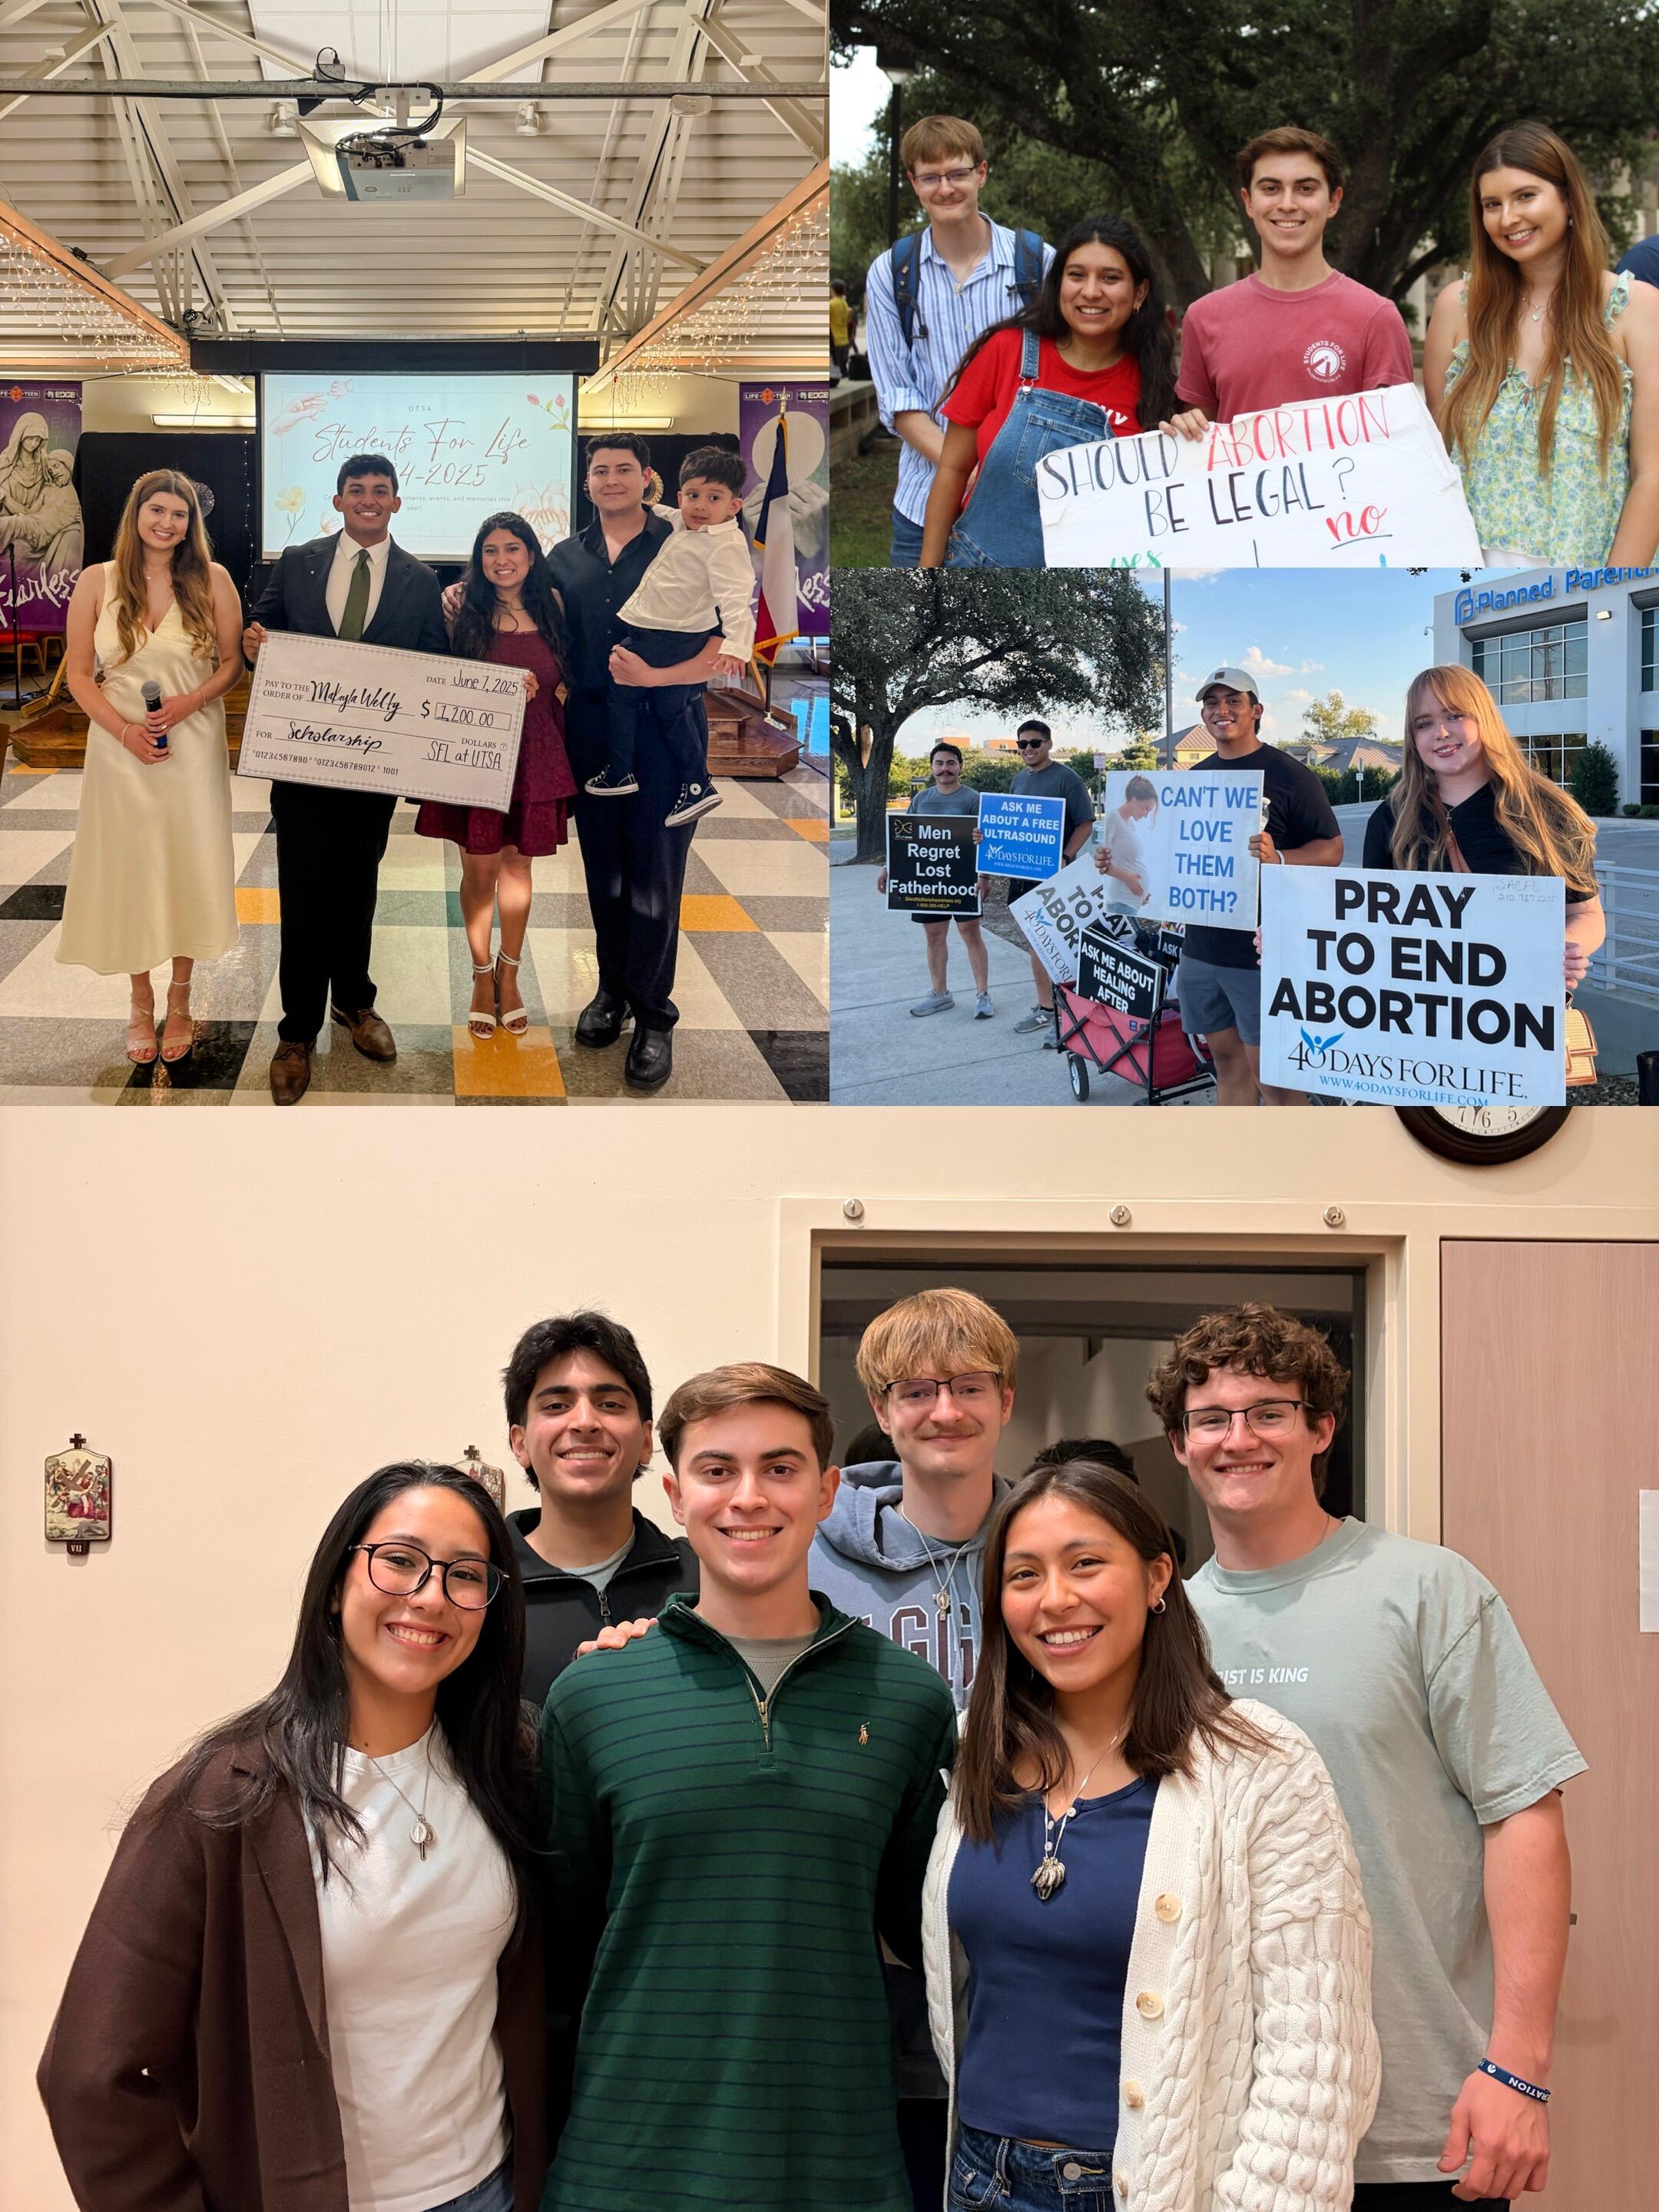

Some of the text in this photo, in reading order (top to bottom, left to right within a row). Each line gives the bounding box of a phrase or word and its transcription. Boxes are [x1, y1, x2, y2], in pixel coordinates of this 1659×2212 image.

[1303, 340, 1330, 364] STUDENTS
[1330, 343, 1343, 355] FOR
[313, 416, 531, 465] Students For Life
[1042, 396, 1389, 500] SHOULD ABORTION
[394, 462, 488, 486] 4-2025
[1145, 483, 1190, 537] BE
[1326, 505, 1387, 542] no
[1478, 575, 1553, 614] Planned
[265, 680, 280, 688] PAY
[294, 684, 310, 692] THE
[426, 676, 447, 685] DATE
[453, 669, 519, 694] June 7, 2025
[263, 690, 291, 700] ORDER
[420, 699, 431, 719] $
[256, 730, 272, 739] FOR
[287, 720, 382, 755] Scholarship
[461, 737, 497, 749] DOLLARS
[427, 741, 502, 769] SFL at UTSA
[1001, 801, 1042, 814] ASK ME
[1161, 785, 1259, 808] CAN'T WE
[919, 825, 952, 840] Men
[982, 813, 1059, 831] ABOUT A FREE
[1179, 820, 1233, 843] LOVE
[984, 828, 1056, 845] ULTRASOUND
[908, 843, 961, 861] Regret
[916, 862, 952, 877] Lost
[1174, 853, 1234, 878] THEM
[889, 879, 977, 896] Fatherhood
[1169, 886, 1237, 913] BOTH?
[1068, 885, 1092, 919] TO
[1335, 879, 1476, 929] PRAY
[1035, 886, 1079, 958] ABOR
[1162, 942, 1178, 957] ASK
[1307, 929, 1507, 987] TO END
[1081, 942, 1100, 962] ASK
[1101, 952, 1116, 971] ME
[1117, 962, 1154, 992] ABOUT
[1093, 964, 1136, 1001] HEALING
[1097, 985, 1129, 1014] AFTER
[1268, 977, 1555, 1051] ABORTION
[1288, 1040, 1326, 1071] 40
[1330, 1049, 1393, 1081] DAYS
[1399, 1058, 1461, 1089] FOR
[1482, 1111, 1491, 1128] 6
[1250, 1667, 1265, 1684] IS
[1269, 1667, 1309, 1683] KING
